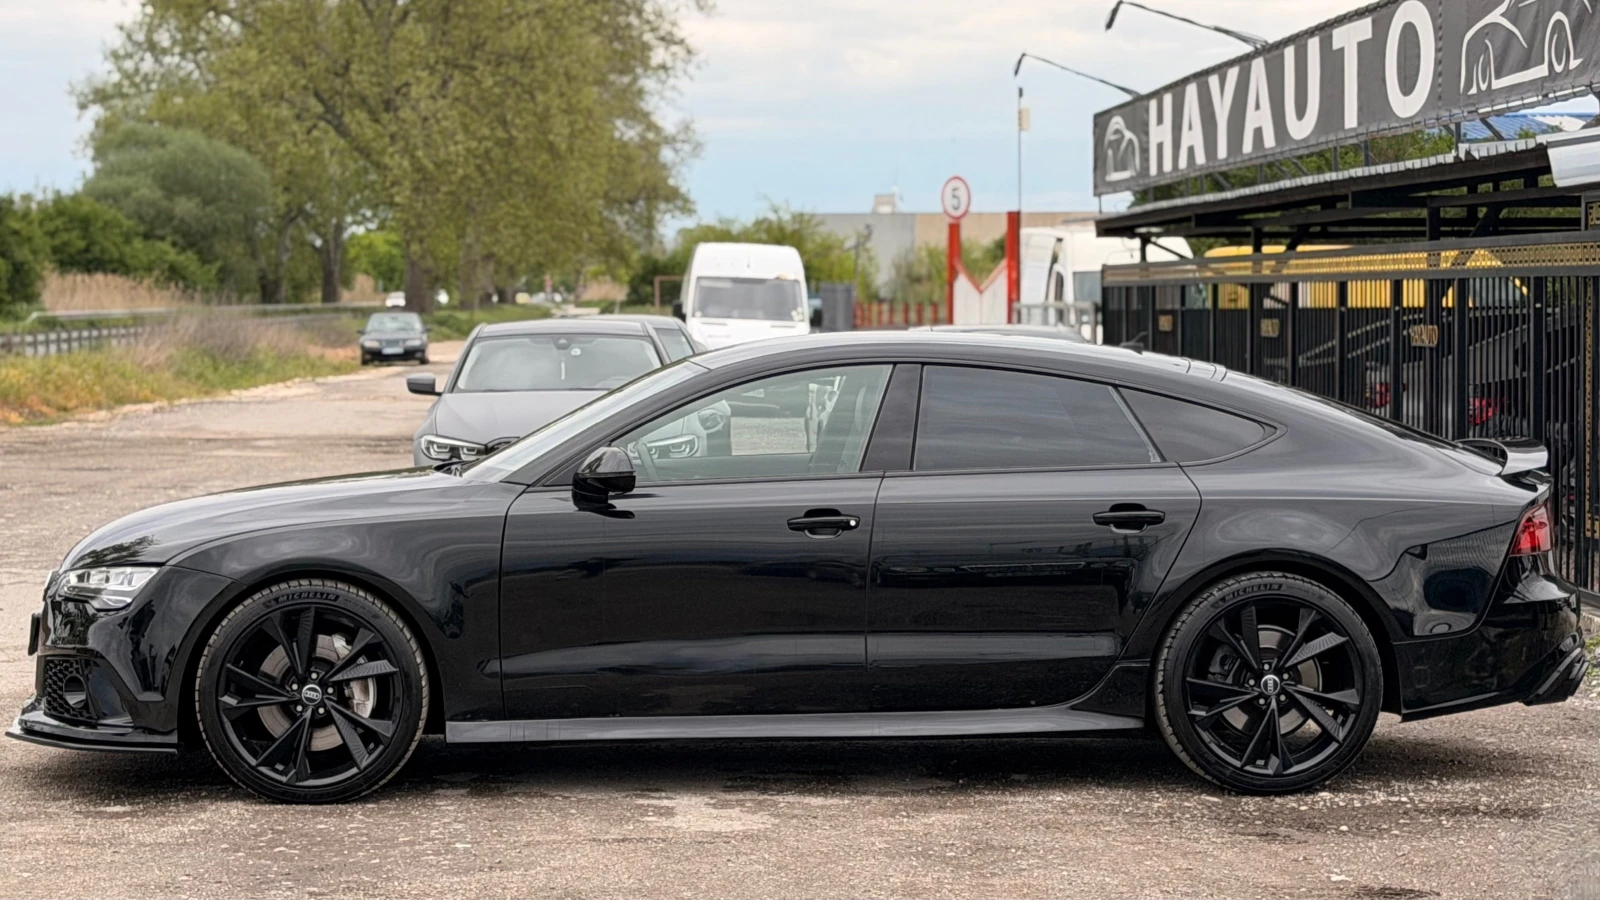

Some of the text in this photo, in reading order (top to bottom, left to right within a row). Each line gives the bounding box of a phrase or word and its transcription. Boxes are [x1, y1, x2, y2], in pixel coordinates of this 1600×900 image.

[1149, 0, 1435, 176] HAYAUTO
[952, 187, 961, 210] 5
[279, 591, 337, 602] MICHELIN
[1225, 584, 1280, 601] MICHELIN
